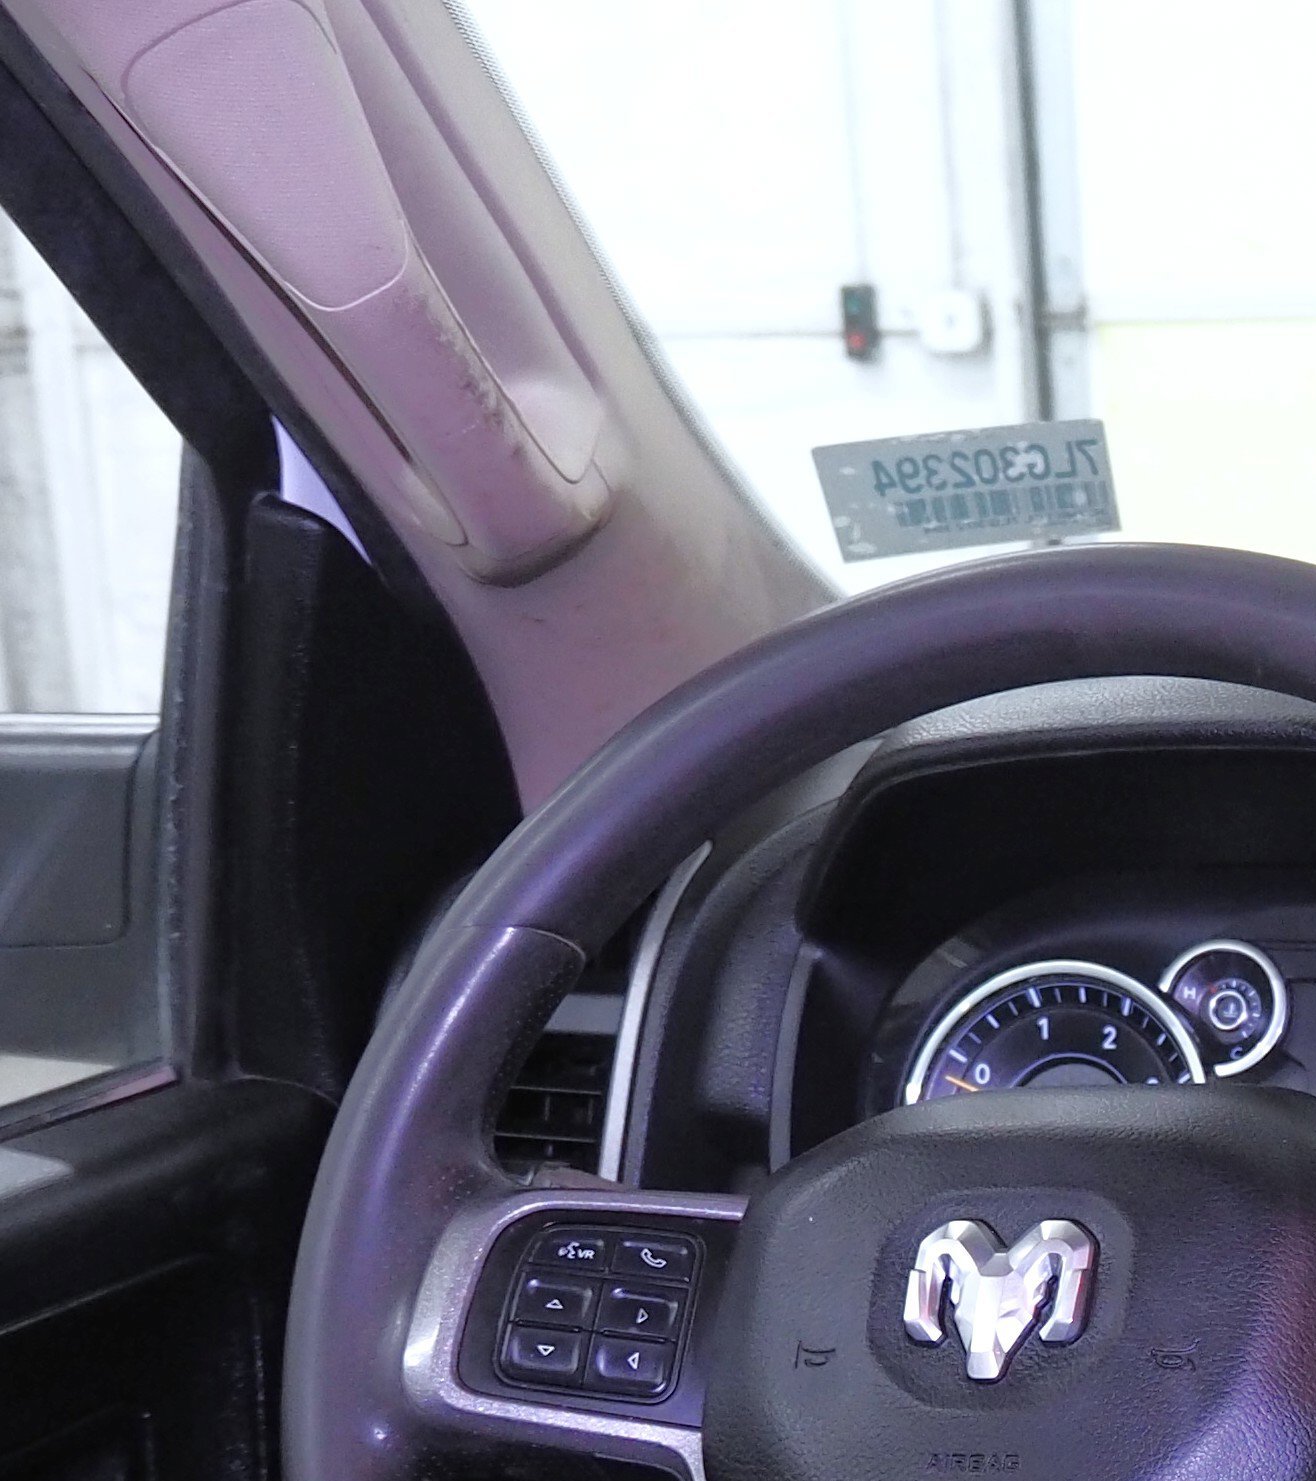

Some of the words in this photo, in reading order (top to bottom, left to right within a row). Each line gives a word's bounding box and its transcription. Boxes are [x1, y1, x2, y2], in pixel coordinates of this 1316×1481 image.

[1036, 1017, 1051, 1040] 1
[1102, 1026, 1117, 1049] 2
[974, 1062, 991, 1085] 0
